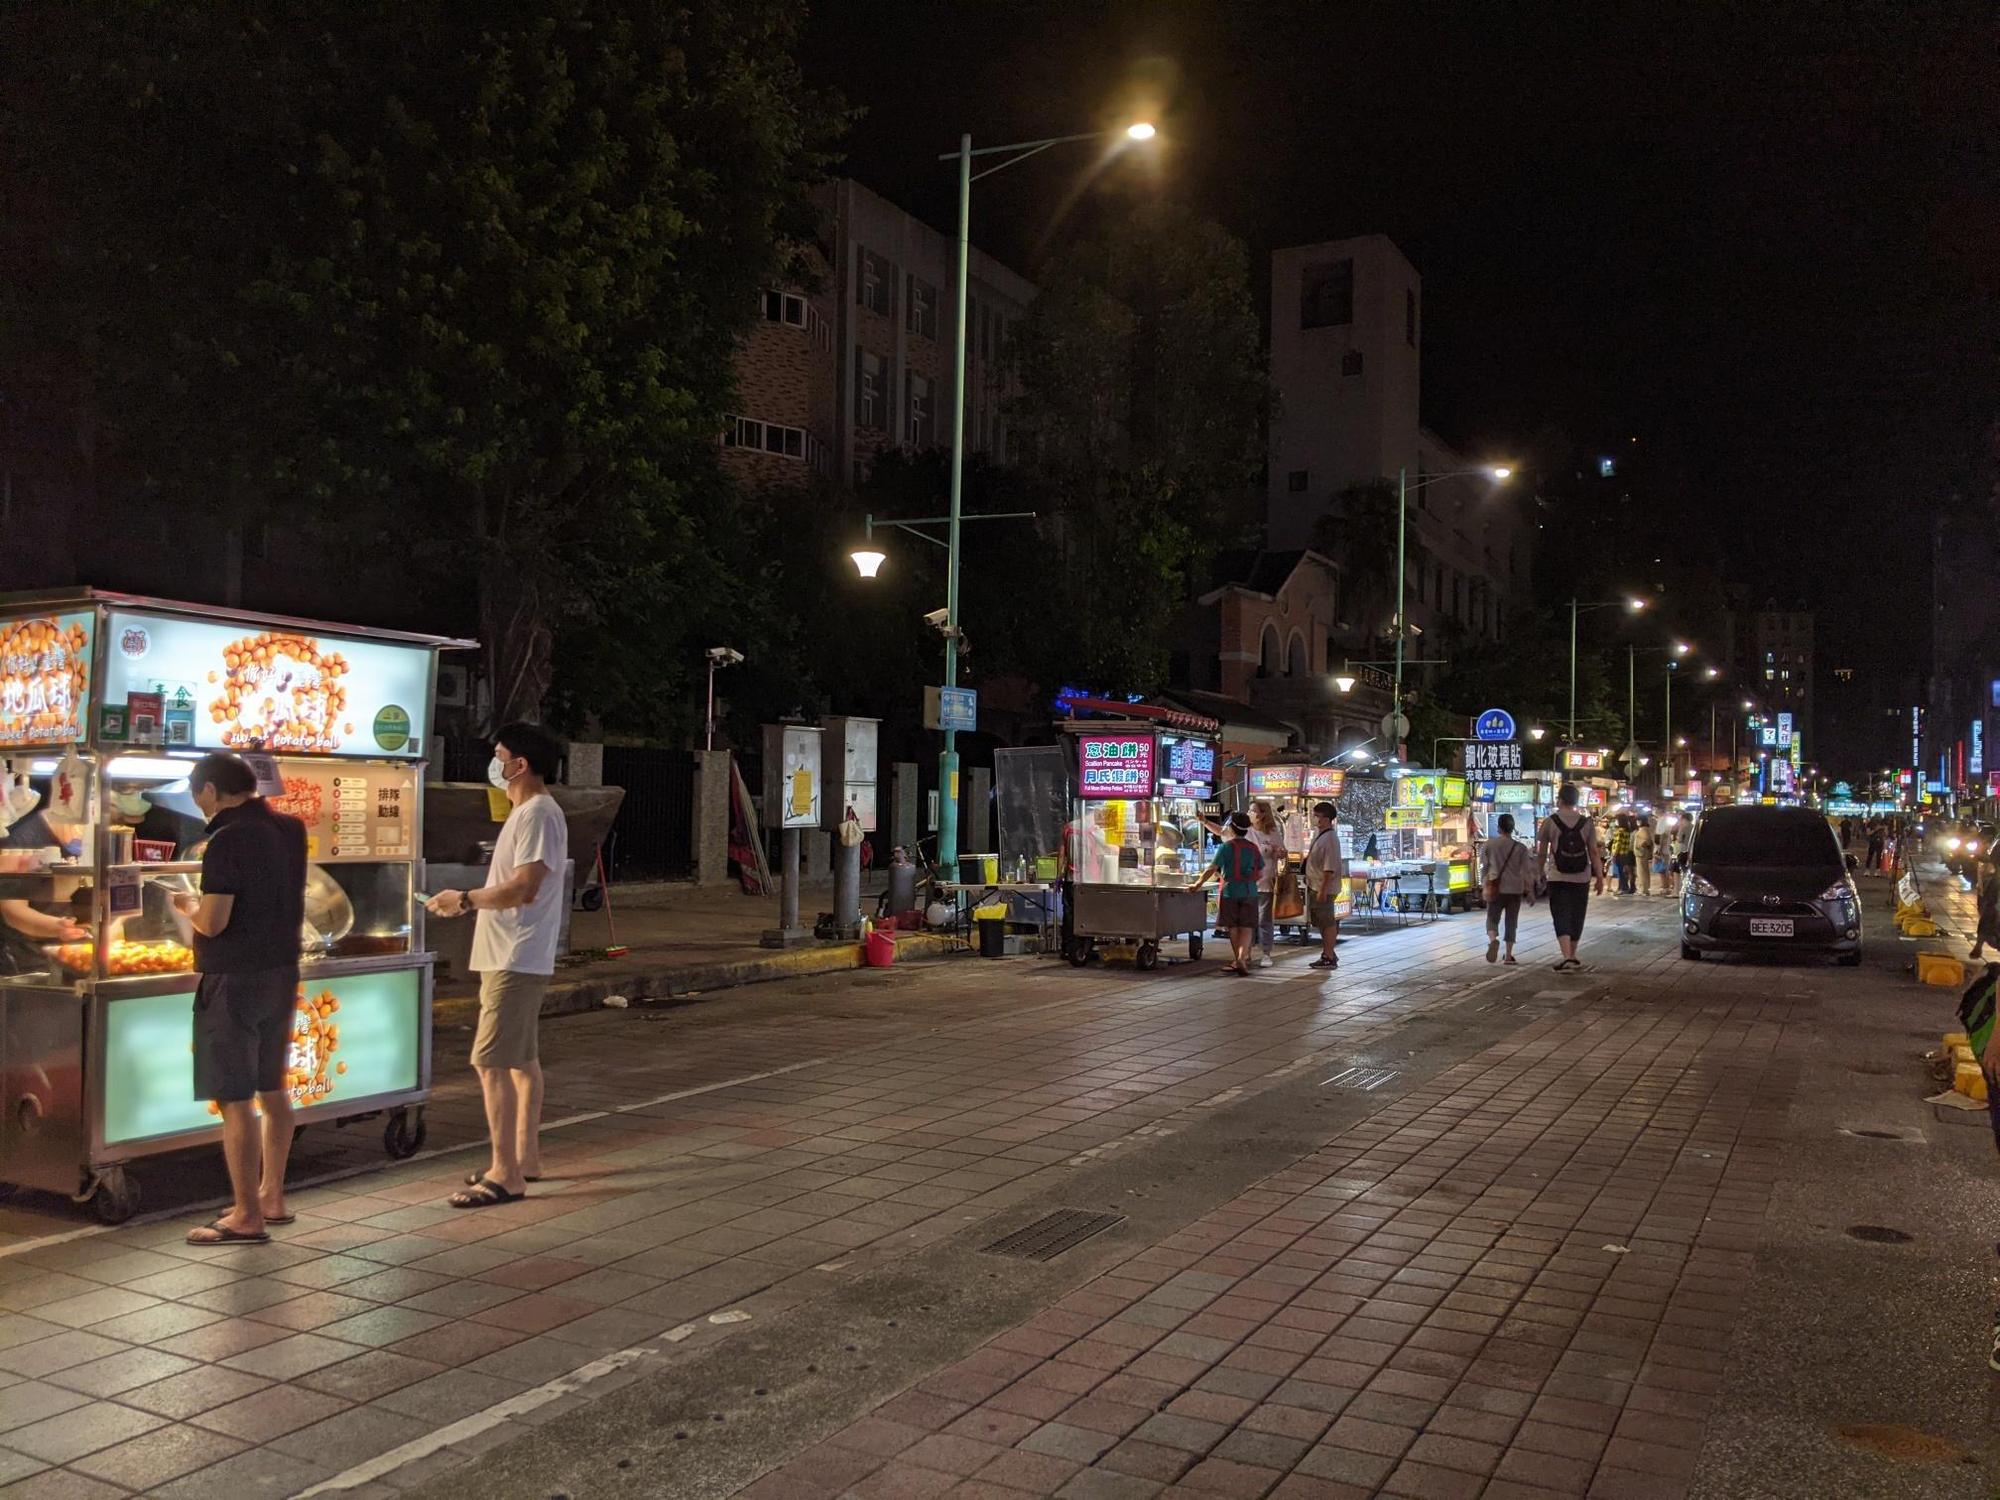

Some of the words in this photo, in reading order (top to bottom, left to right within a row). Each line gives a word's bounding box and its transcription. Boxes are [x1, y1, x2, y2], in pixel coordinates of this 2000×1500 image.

[4, 674, 72, 715] 地瓜球
[273, 733, 311, 747] potato
[316, 733, 338, 747] ball
[1139, 743, 1150, 751] 50
[1465, 743, 1522, 768] 鋼化玻璃貼
[1139, 770, 1150, 778] 60
[377, 787, 400, 801] 排隊
[377, 804, 400, 818] 動線
[1751, 922, 1793, 934] BEE-3205
